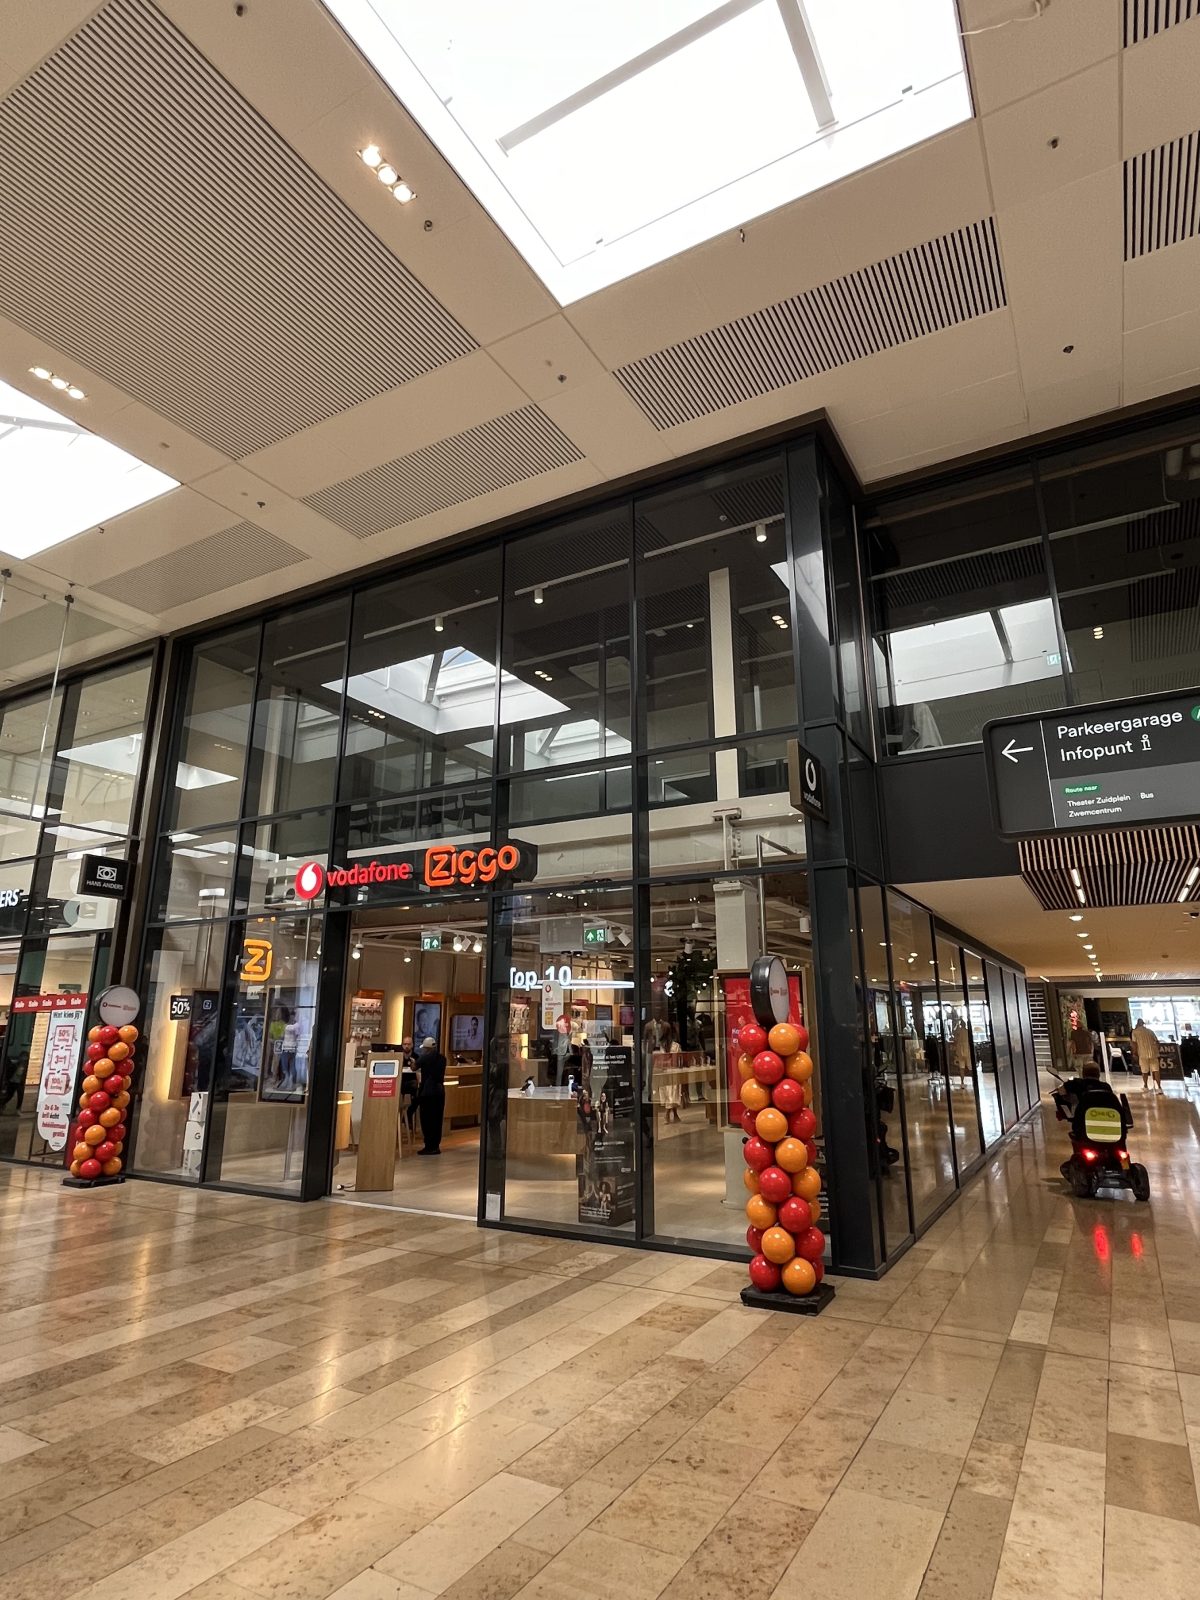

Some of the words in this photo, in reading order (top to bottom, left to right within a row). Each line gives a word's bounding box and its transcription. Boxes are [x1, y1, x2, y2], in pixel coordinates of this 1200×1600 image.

[1057, 711, 1183, 739] Parkeergarage
[1060, 740, 1134, 762] Infopunt
[1067, 799, 1095, 807] Theater
[1096, 794, 1131, 804] Zuidplein
[1140, 792, 1154, 800] Bus
[1068, 806, 1122, 818] Zwemcentrum
[326, 860, 412, 887] vodafone
[102, 882, 124, 890] ANDERS
[545, 965, 572, 986] 10
[171, 1002, 191, 1014] 50%
[1160, 1059, 1174, 1069] 65
